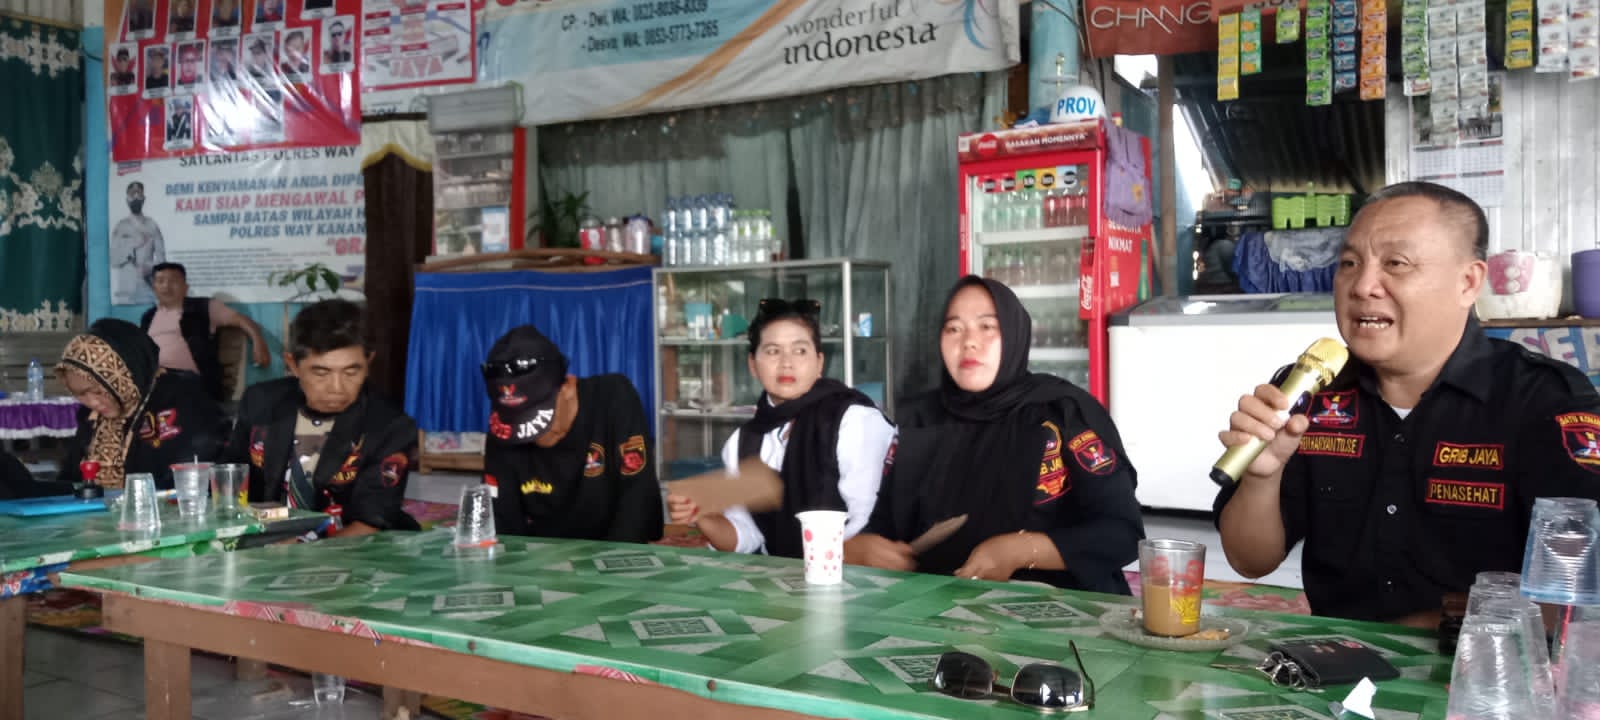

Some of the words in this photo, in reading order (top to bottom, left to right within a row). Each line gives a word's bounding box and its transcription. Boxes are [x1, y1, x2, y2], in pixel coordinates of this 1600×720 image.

[785, 0, 901, 36] wonderful
[784, 22, 938, 64] indonesia
[1057, 96, 1096, 116] PROV
[165, 182, 194, 195] DEMI
[198, 177, 287, 194] KENYAMANAN
[291, 174, 328, 188] ANDA
[175, 197, 211, 212] KAMI
[215, 197, 250, 210] SIAP
[255, 191, 347, 208] MENGAWAL
[193, 211, 240, 226] SAMPAI
[244, 210, 287, 223] BATAS
[291, 207, 352, 221] WILAYAH
[229, 225, 280, 239] POLRES
[284, 223, 313, 236] WAY
[316, 222, 366, 236] KANAN
[517, 409, 554, 439] JAYA
[1439, 446, 1469, 463] GRIB
[1468, 448, 1500, 465] JAYA
[1430, 483, 1498, 504] PENASEHAT
